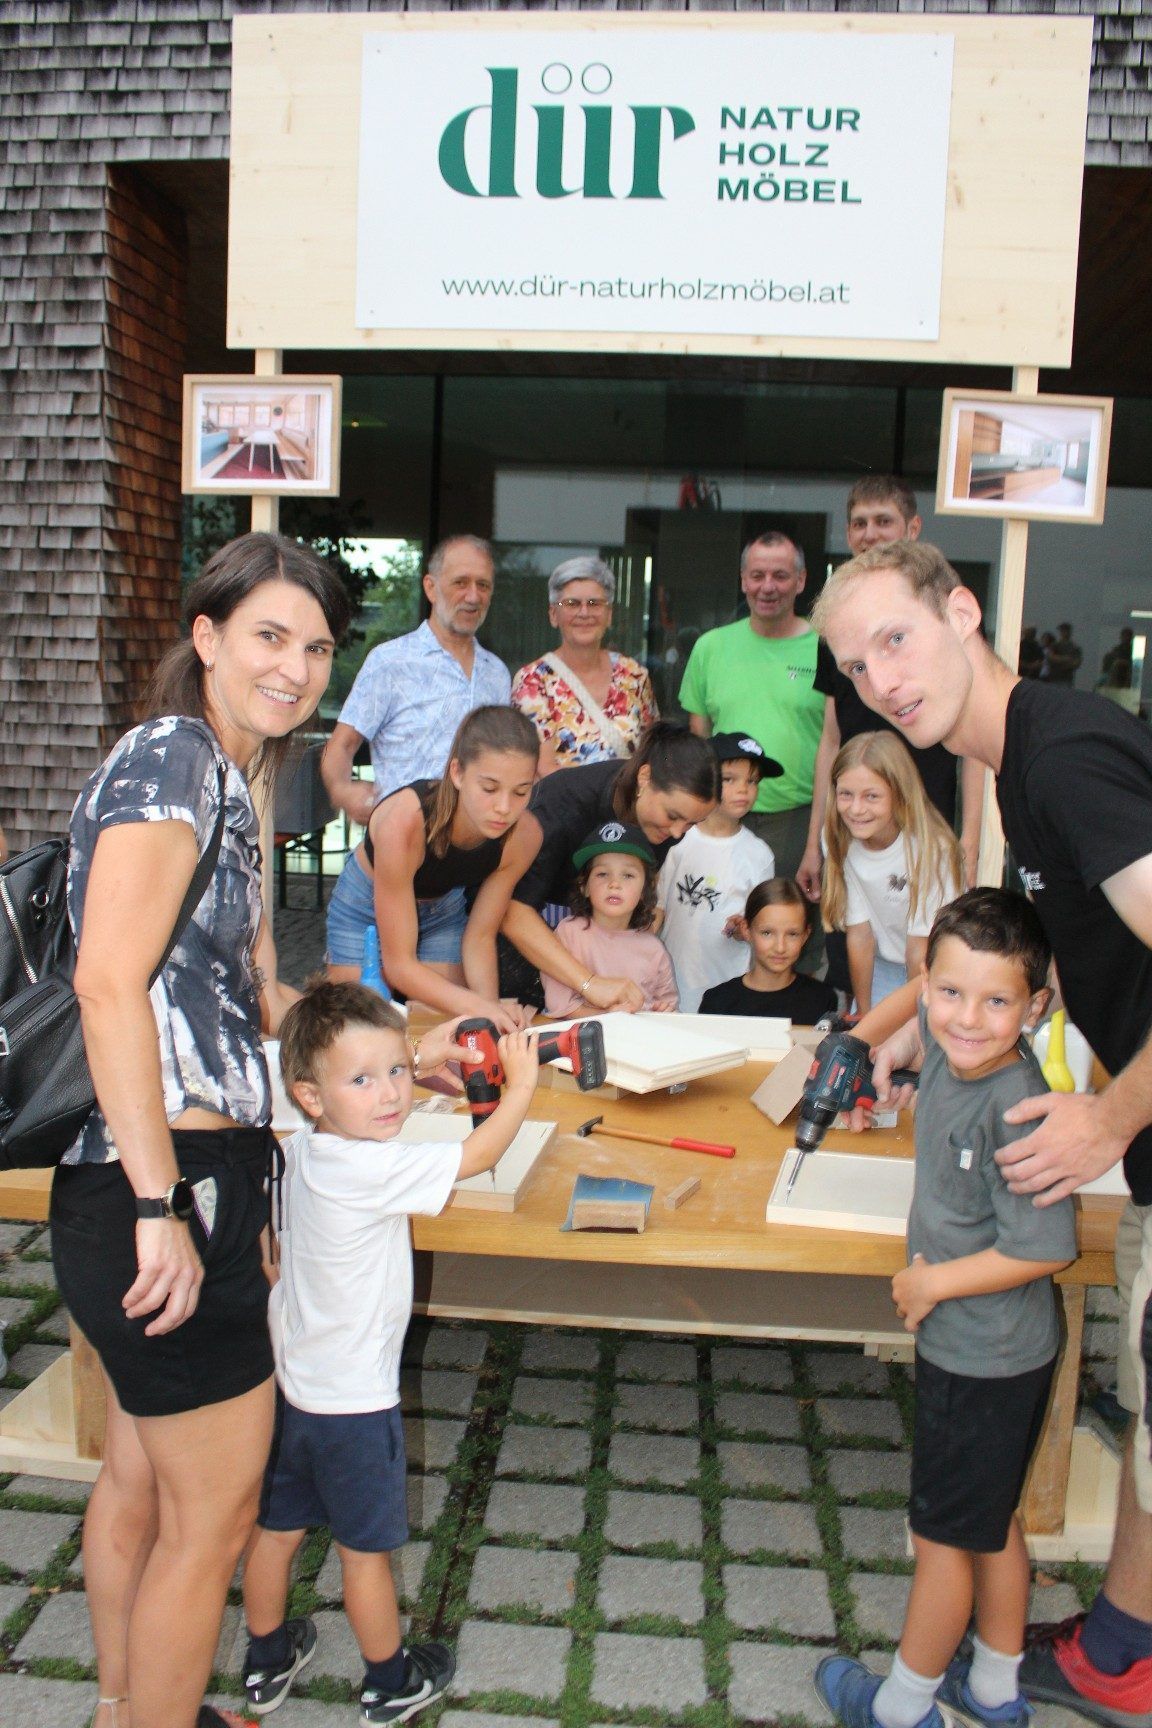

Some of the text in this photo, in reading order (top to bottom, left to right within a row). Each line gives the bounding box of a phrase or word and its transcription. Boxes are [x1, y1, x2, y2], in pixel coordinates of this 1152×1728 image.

[437, 63, 696, 200] dür
[721, 107, 860, 131] NATUR
[720, 143, 828, 166] HOLZ
[718, 173, 861, 203] MÖBEL
[442, 275, 849, 303] www.dür-naturholzmöbel.at
